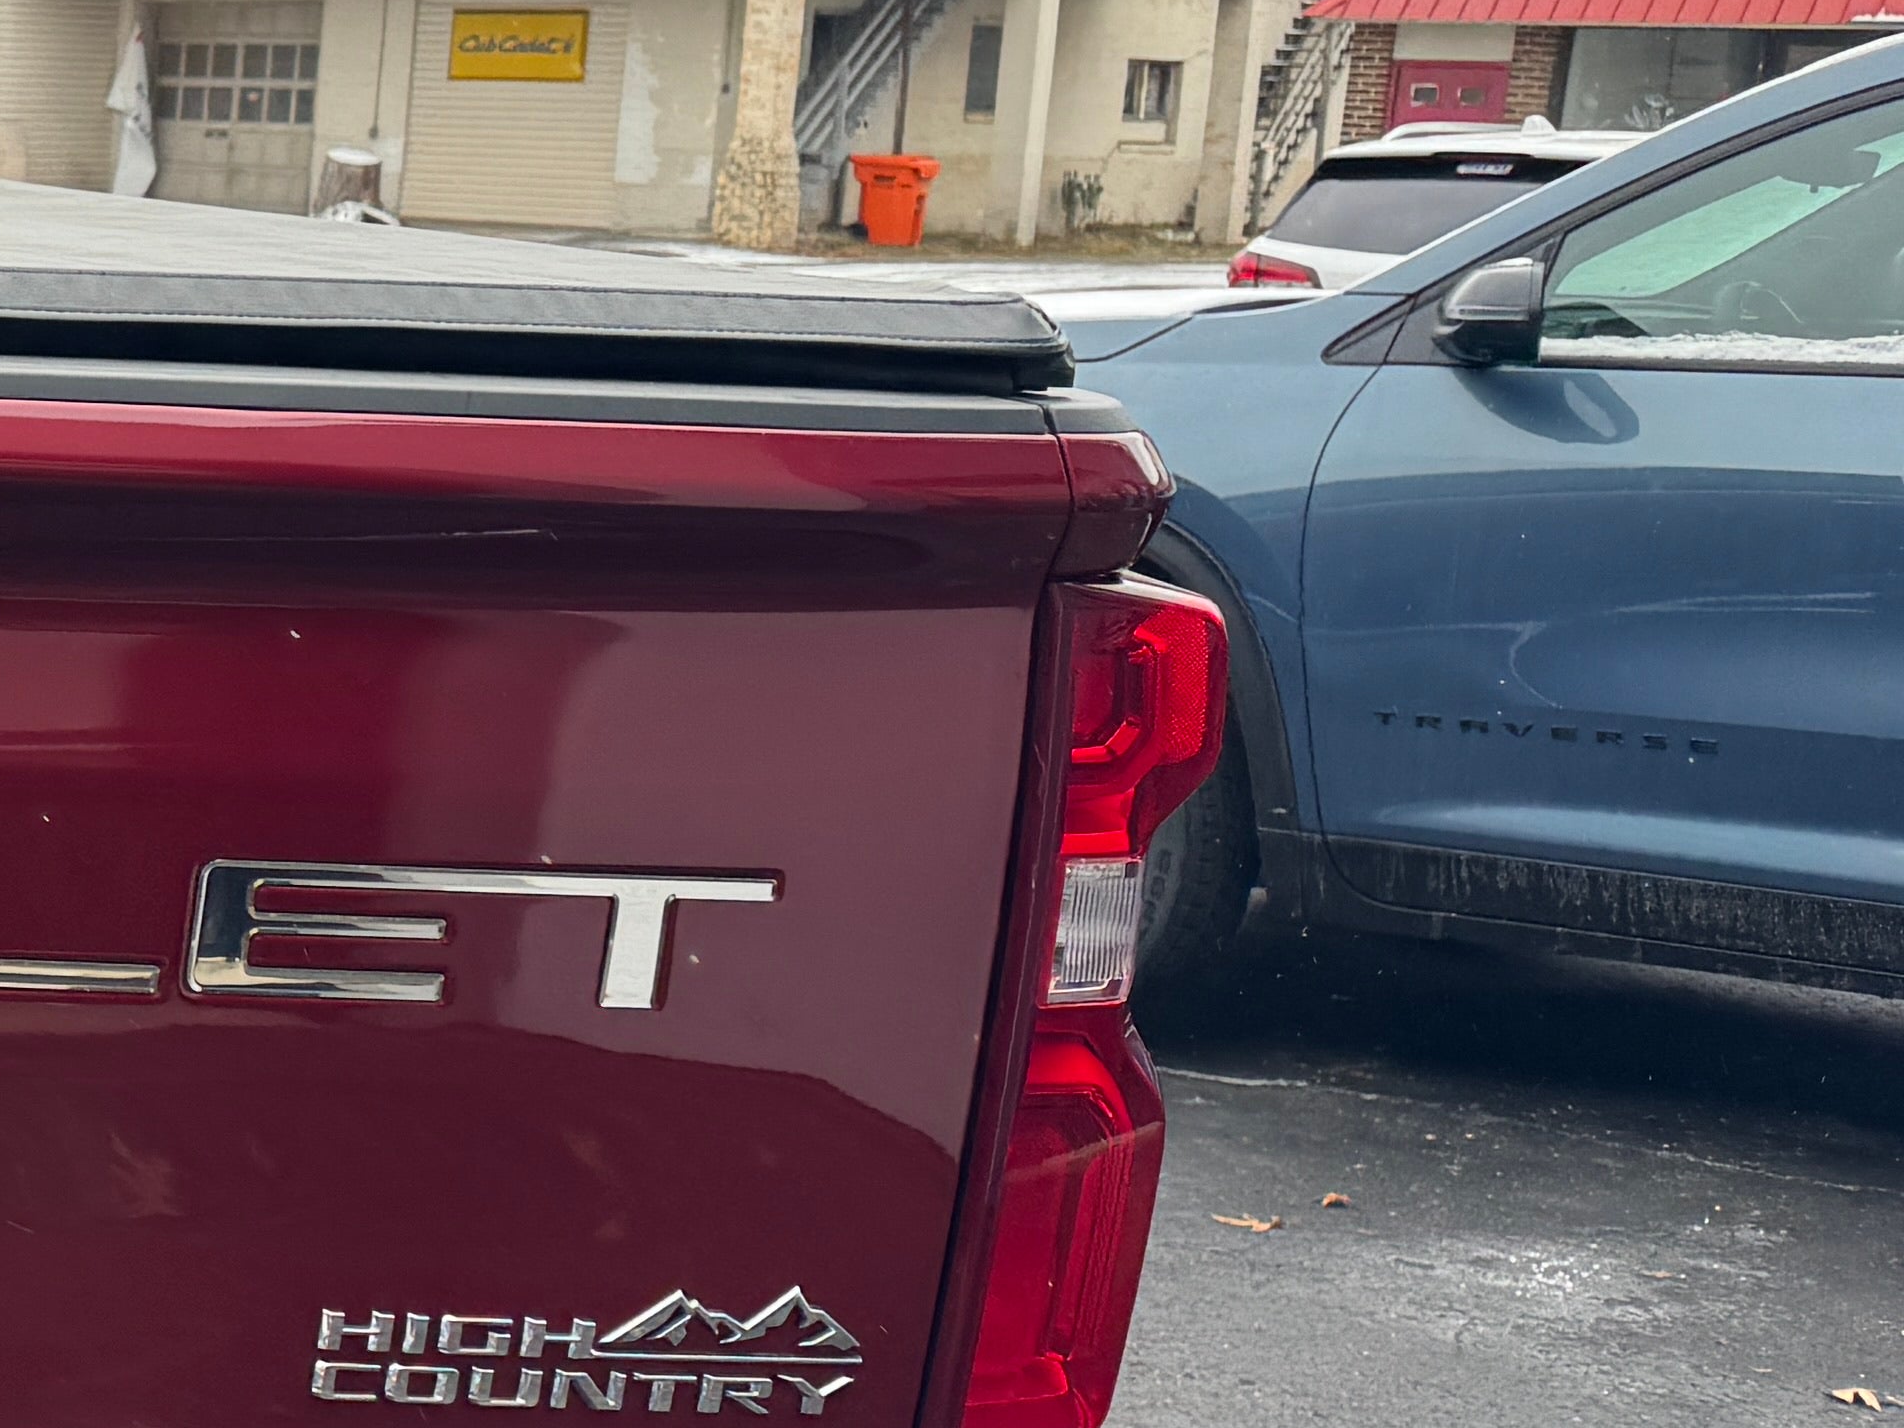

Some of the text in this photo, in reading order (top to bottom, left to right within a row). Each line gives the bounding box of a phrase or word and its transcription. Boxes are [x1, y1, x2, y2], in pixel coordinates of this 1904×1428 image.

[1373, 710, 1719, 755] TRAVERSE
[317, 1308, 597, 1360] HIGH
[311, 1359, 856, 1415] COUNTRY
